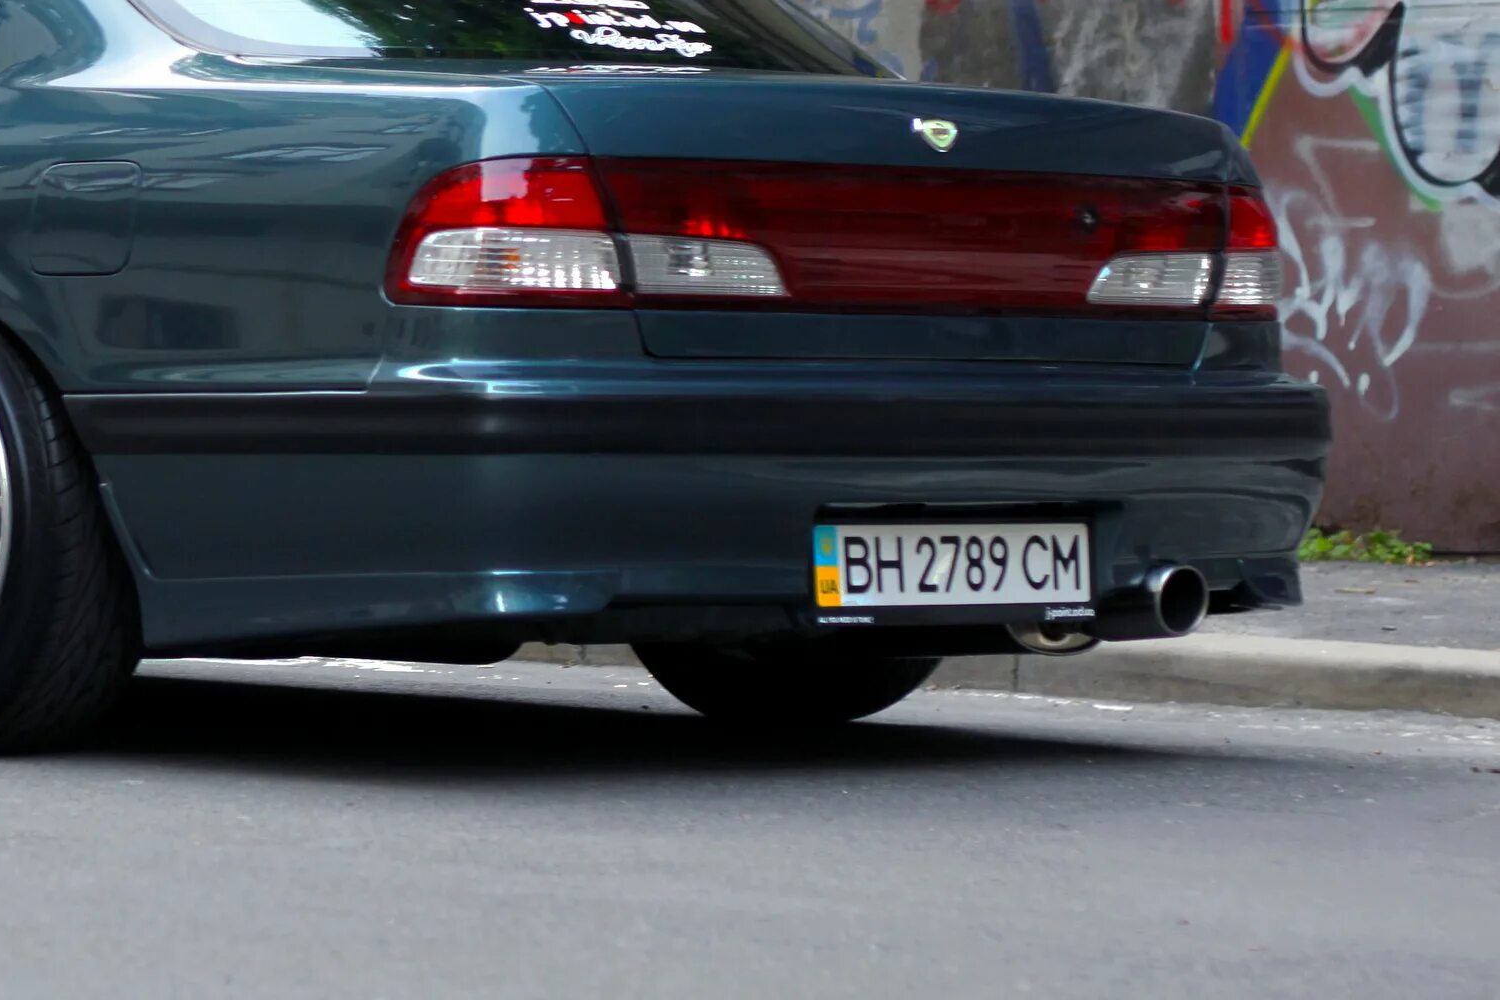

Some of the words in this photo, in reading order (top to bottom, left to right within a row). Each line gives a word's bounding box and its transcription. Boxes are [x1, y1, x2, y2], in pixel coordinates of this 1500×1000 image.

[844, 535, 905, 594] BH
[915, 535, 1009, 593] 2789
[1022, 534, 1081, 591] CM
[820, 579, 840, 595] UA
